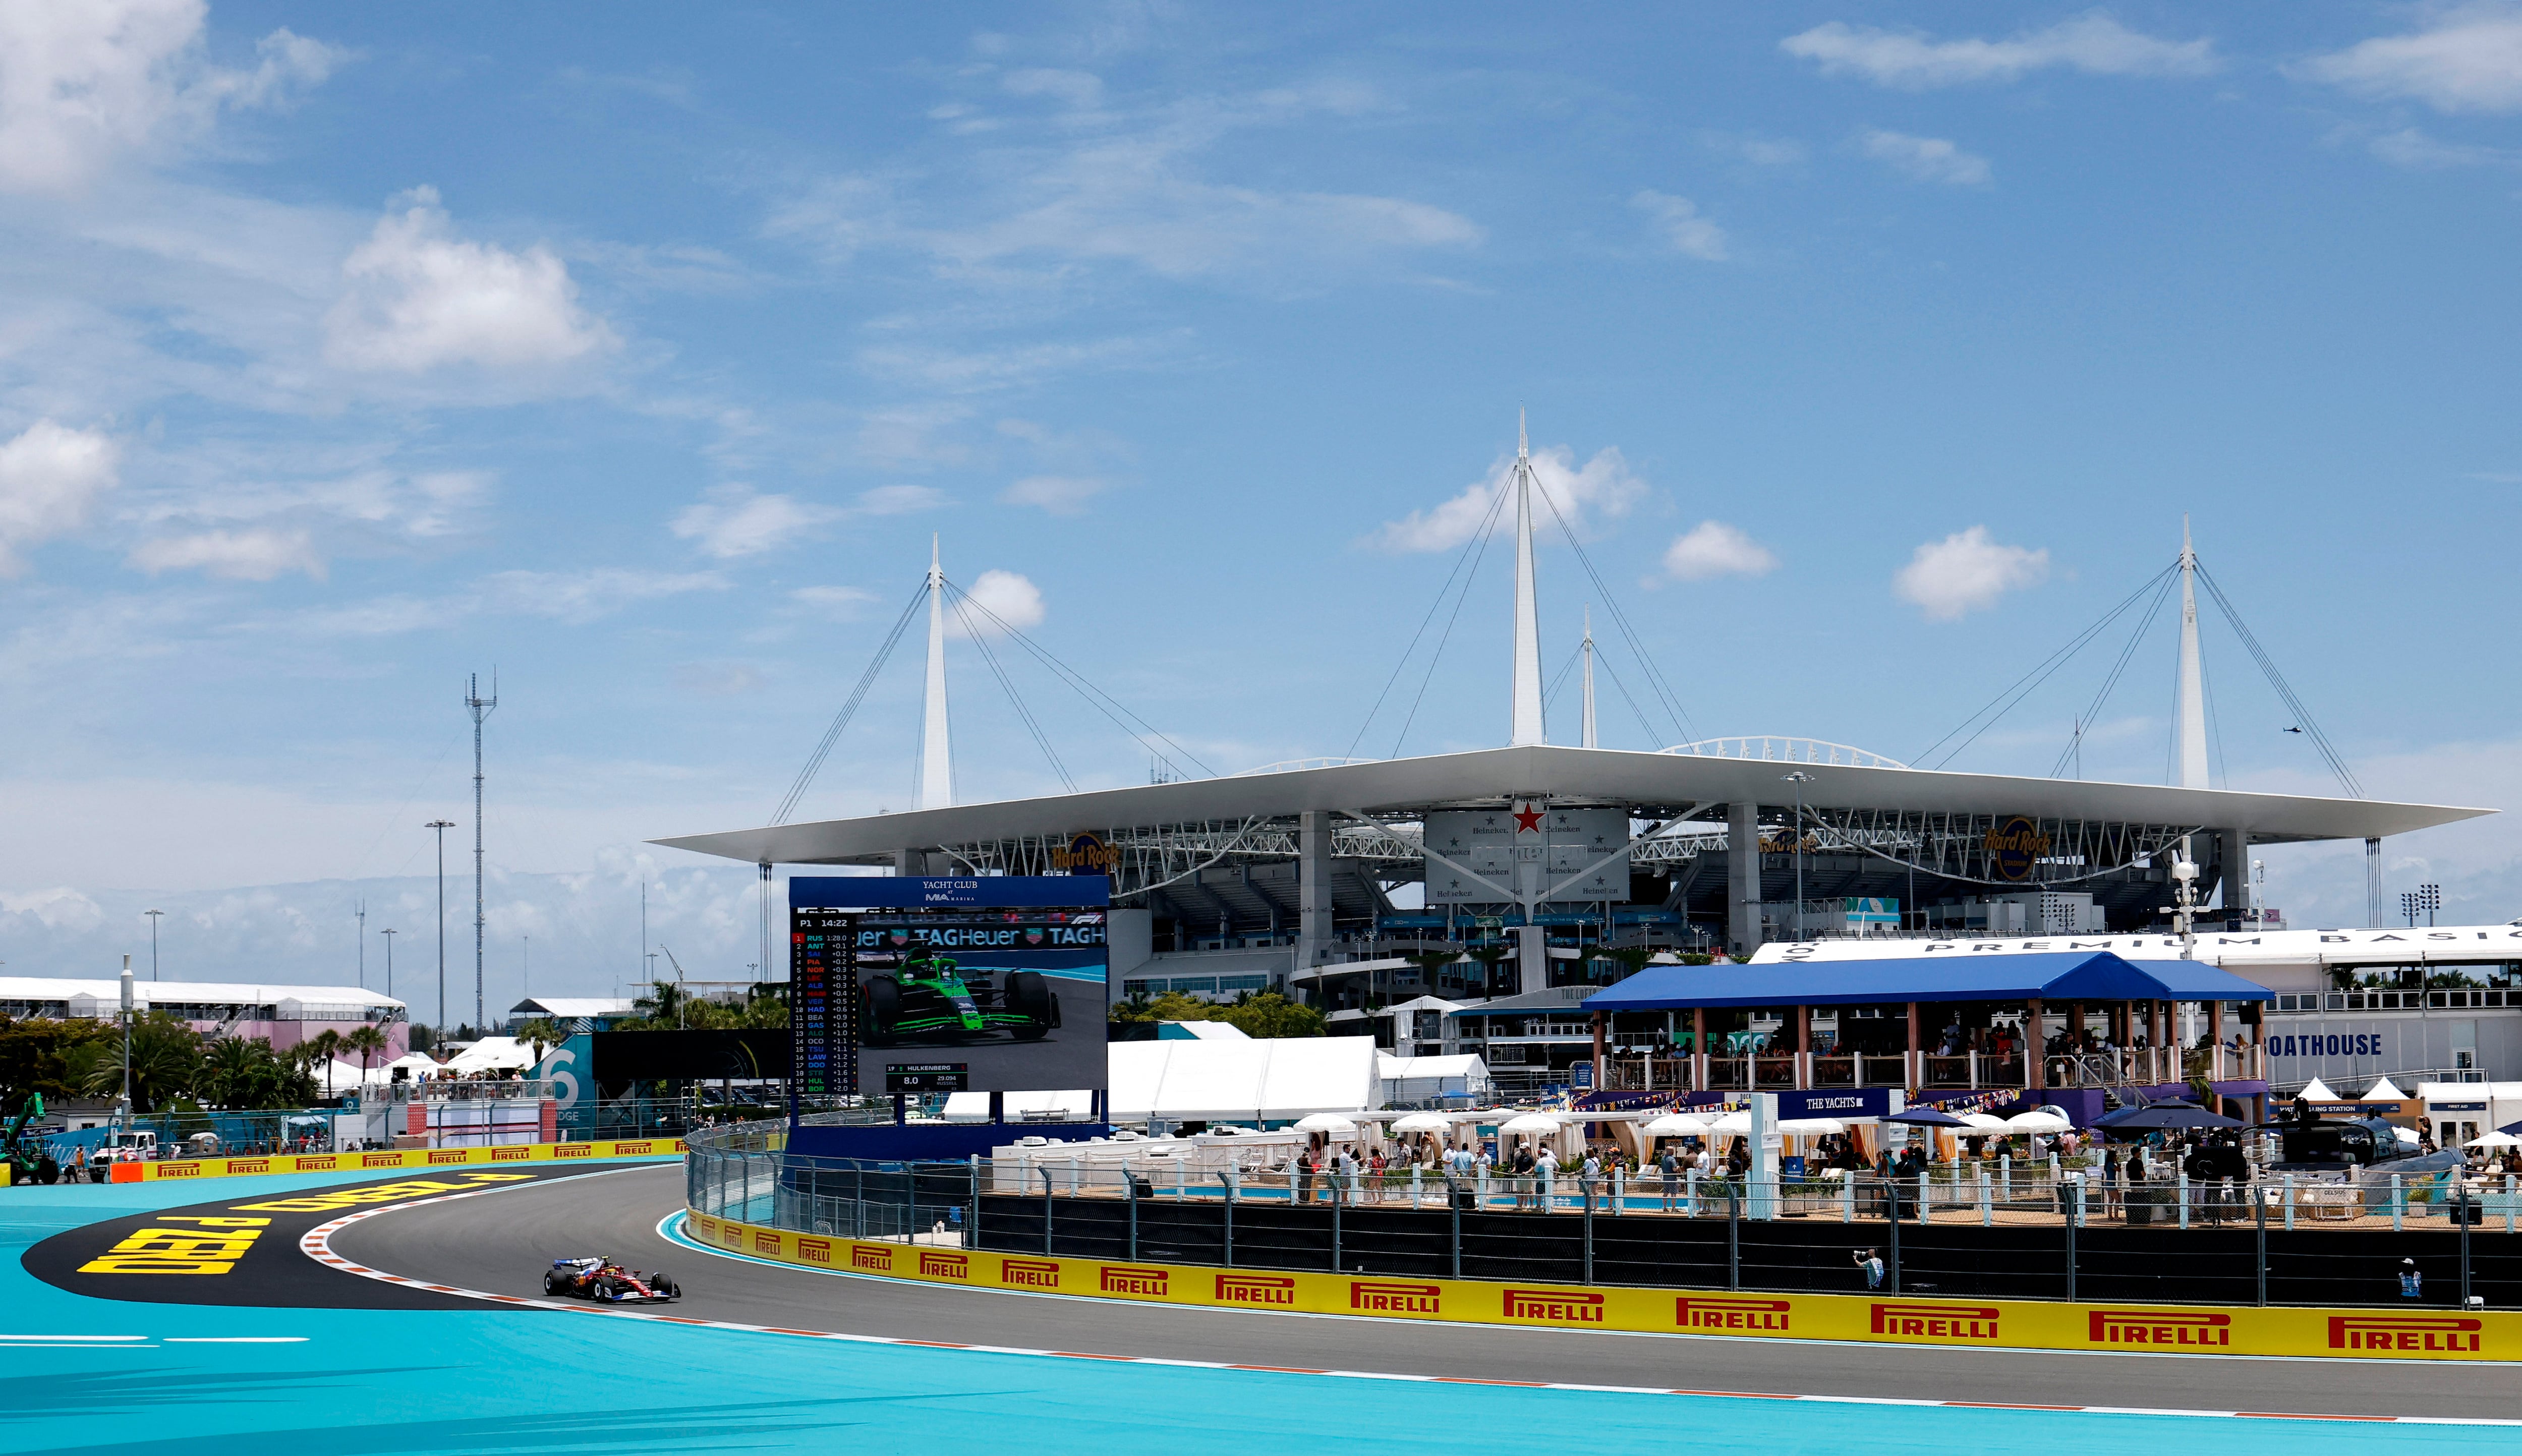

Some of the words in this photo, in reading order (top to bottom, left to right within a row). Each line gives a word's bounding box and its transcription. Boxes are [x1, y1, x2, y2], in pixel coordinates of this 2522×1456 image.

[1984, 828, 2020, 850] Hard
[2019, 830, 2051, 856] Rock
[1052, 844, 1085, 868] Hard
[1086, 842, 1120, 869] Rock
[1562, 989, 1573, 999] THE
[2264, 1034, 2381, 1057] OATHOUSE
[540, 1049, 579, 1110] 6
[347, 1101, 354, 1112] 9
[1807, 1099, 1823, 1109] THE
[1825, 1097, 1855, 1108] YACHTS
[428, 1150, 467, 1163] PIRELLI
[492, 1147, 530, 1160] PIRELLI
[554, 1145, 591, 1157] PIRELLI
[615, 1142, 652, 1154] PIRELLI
[157, 1163, 200, 1177] PIRELLI
[227, 1159, 269, 1173] PIRELLI
[296, 1156, 336, 1170] PIRELLI
[363, 1153, 403, 1167] PIRELLI
[725, 1225, 741, 1248] PIRELLI
[756, 1232, 780, 1255] PIRELLI
[799, 1239, 830, 1262] PIRELLI
[852, 1245, 892, 1270] PIRELLI
[920, 1252, 968, 1278] PIRELLI
[1002, 1259, 1060, 1287] PIRELLI
[1101, 1267, 1169, 1296] PIRELLI
[1216, 1274, 1295, 1304] PIRELLI
[1351, 1282, 1441, 1313] PIRELLI
[1503, 1290, 1605, 1322] PIRELLI
[1676, 1297, 1791, 1330] PIRELLI
[1871, 1304, 2000, 1338] PIRELLI
[2089, 1311, 2231, 1346] PIRELLI
[2328, 1316, 2482, 1352] PIRELLI
